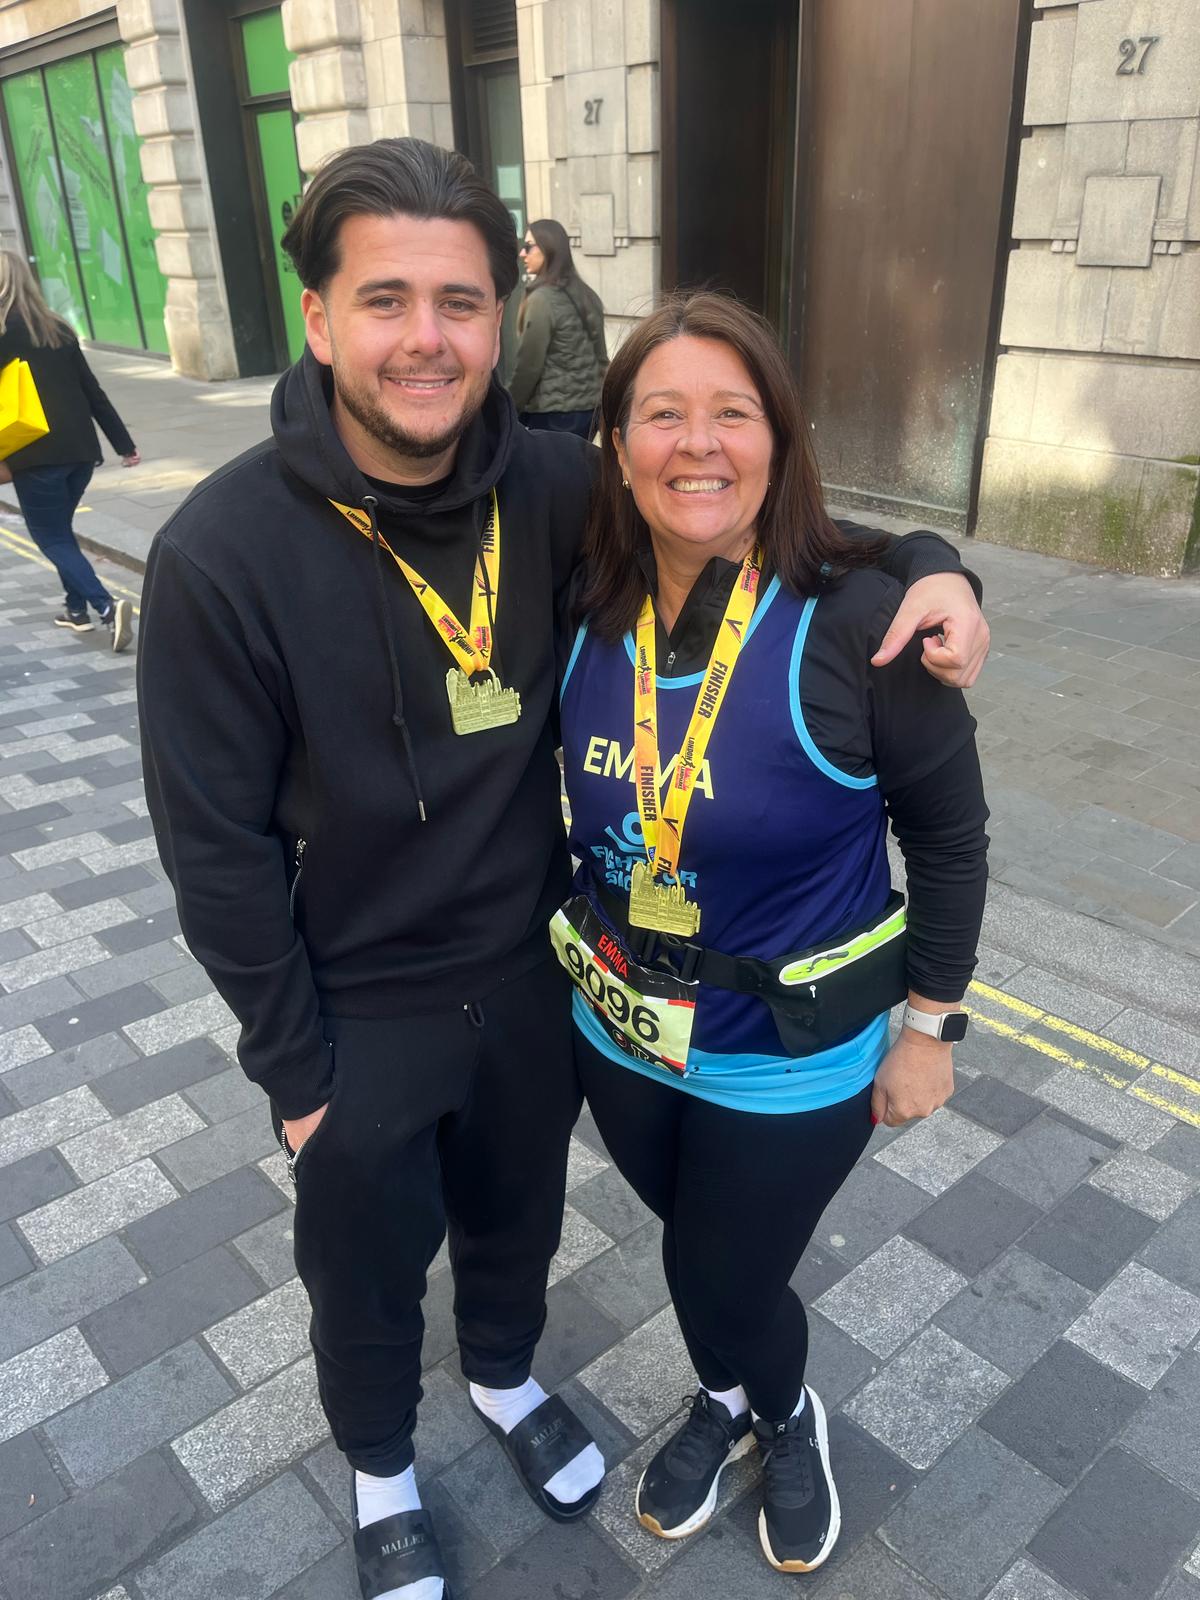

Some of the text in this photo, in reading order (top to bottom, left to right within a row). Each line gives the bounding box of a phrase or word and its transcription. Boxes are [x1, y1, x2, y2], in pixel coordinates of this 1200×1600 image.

[1115, 36, 1160, 76] 27
[584, 98, 604, 126] 27
[698, 660, 728, 719] FINISHER
[686, 737, 695, 762] LONDON
[640, 766, 657, 821] FINISHER
[597, 934, 628, 978] EMMA
[565, 943, 660, 1043] 9096
